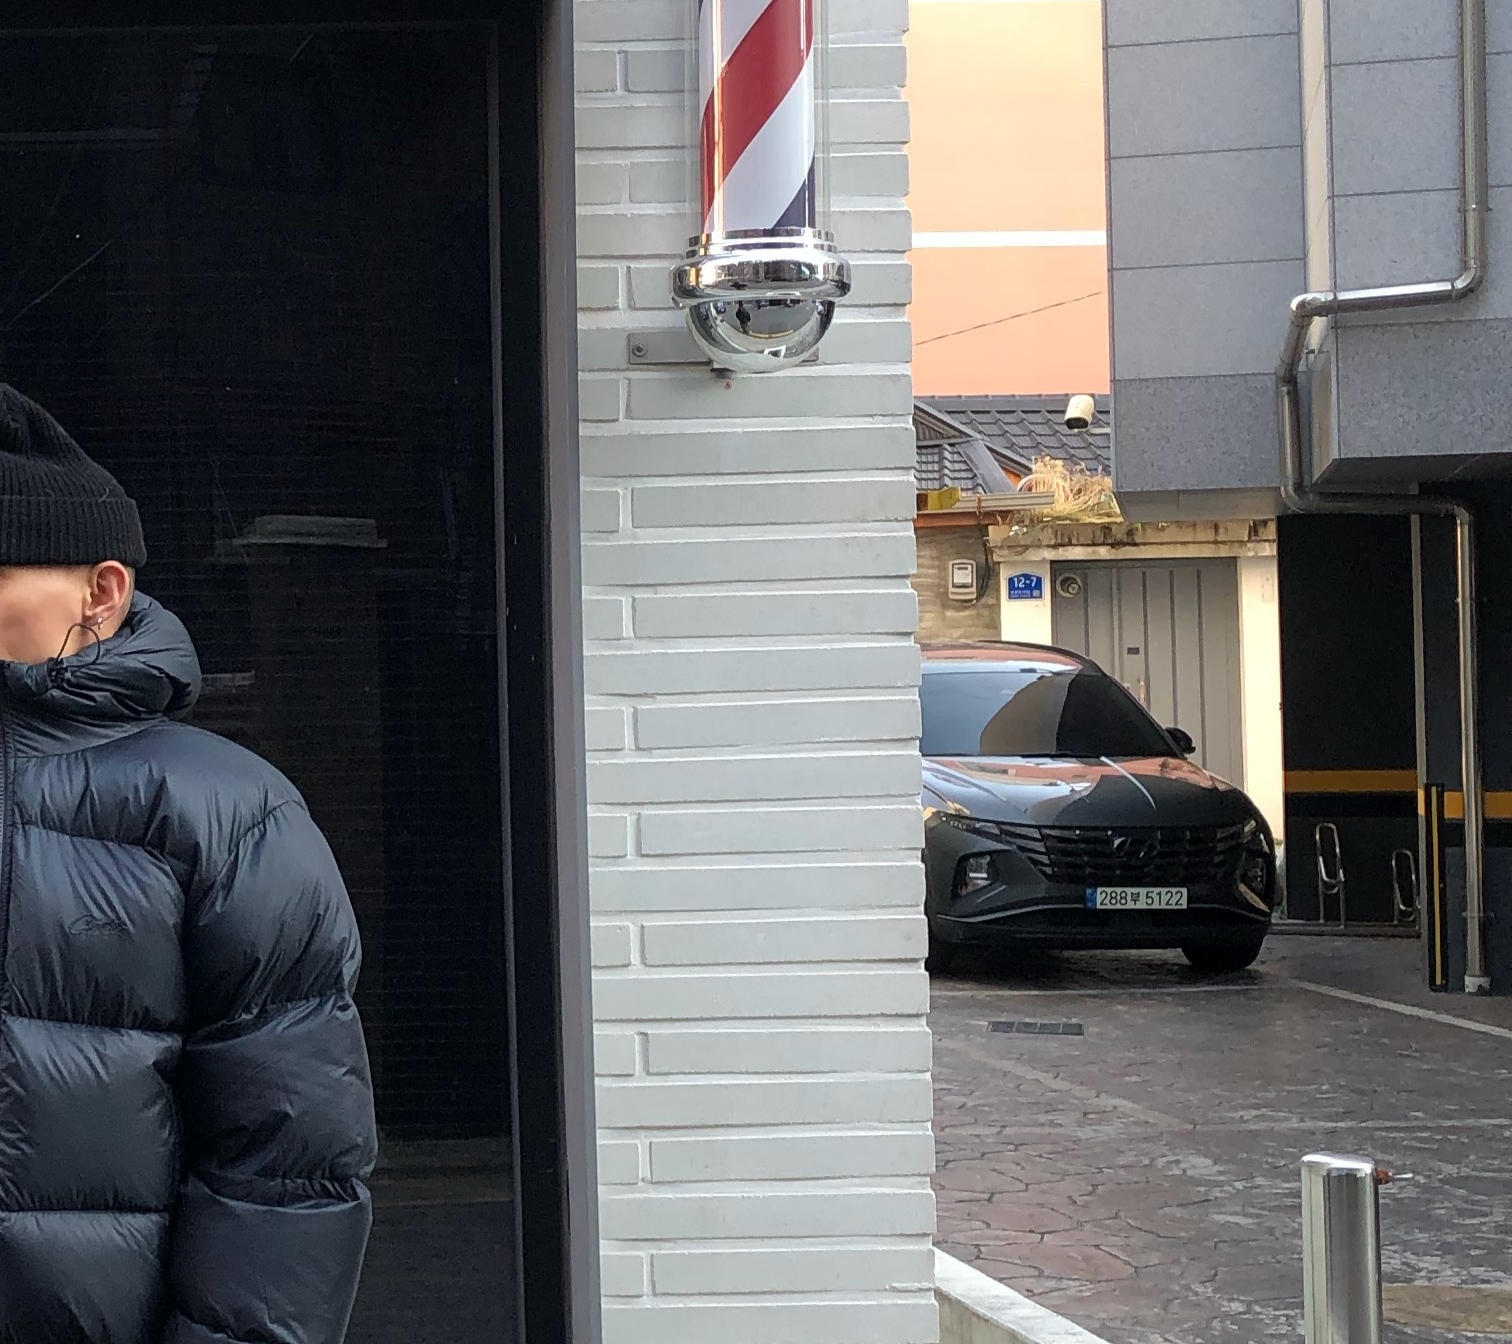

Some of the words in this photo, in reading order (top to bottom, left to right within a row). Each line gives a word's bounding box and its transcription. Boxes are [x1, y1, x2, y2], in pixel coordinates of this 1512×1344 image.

[1013, 576, 1037, 588] 12-7
[1099, 889, 1140, 906] 288부
[1145, 889, 1184, 907] 5122
